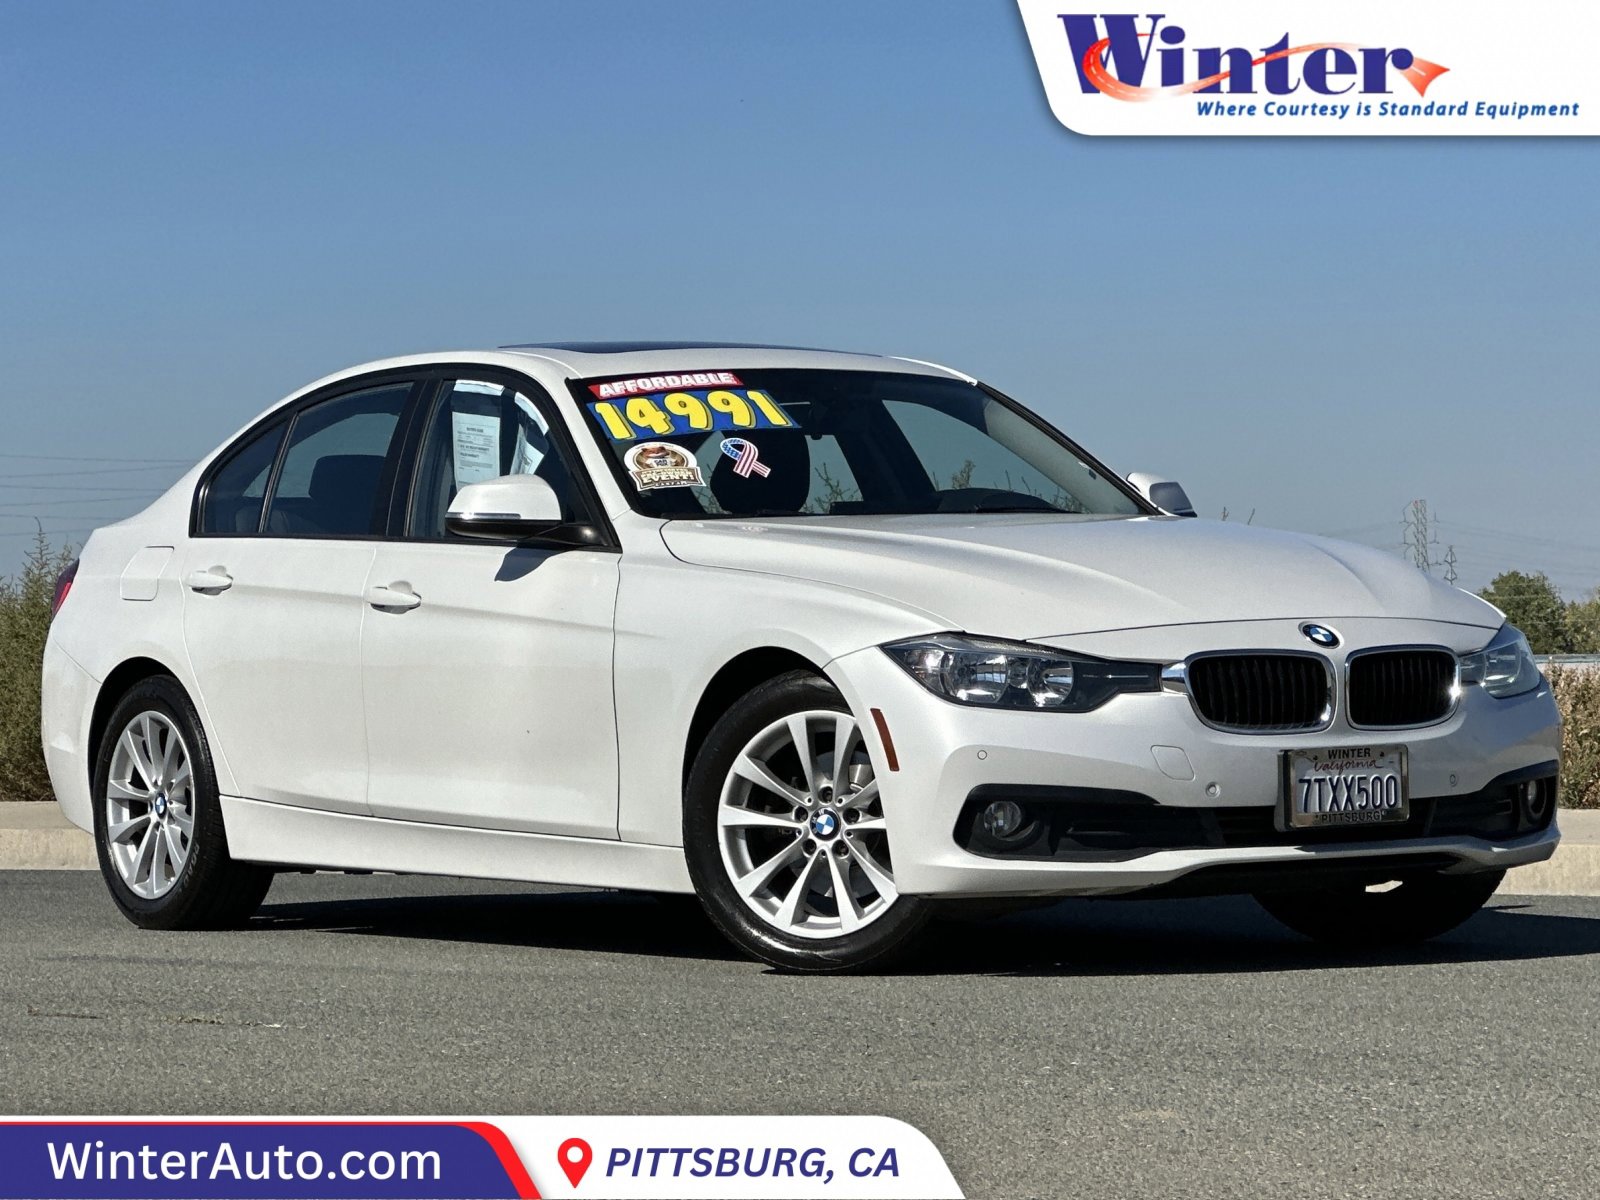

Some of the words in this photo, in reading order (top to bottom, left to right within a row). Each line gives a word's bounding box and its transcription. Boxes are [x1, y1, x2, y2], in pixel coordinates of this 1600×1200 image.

[599, 372, 737, 397] AFFORDABLE
[594, 389, 791, 439] 14991
[1328, 748, 1371, 760] WINTER
[1313, 759, 1384, 776] California
[1298, 773, 1398, 813] 7TXX500
[1321, 810, 1380, 822] PITTSBURG
